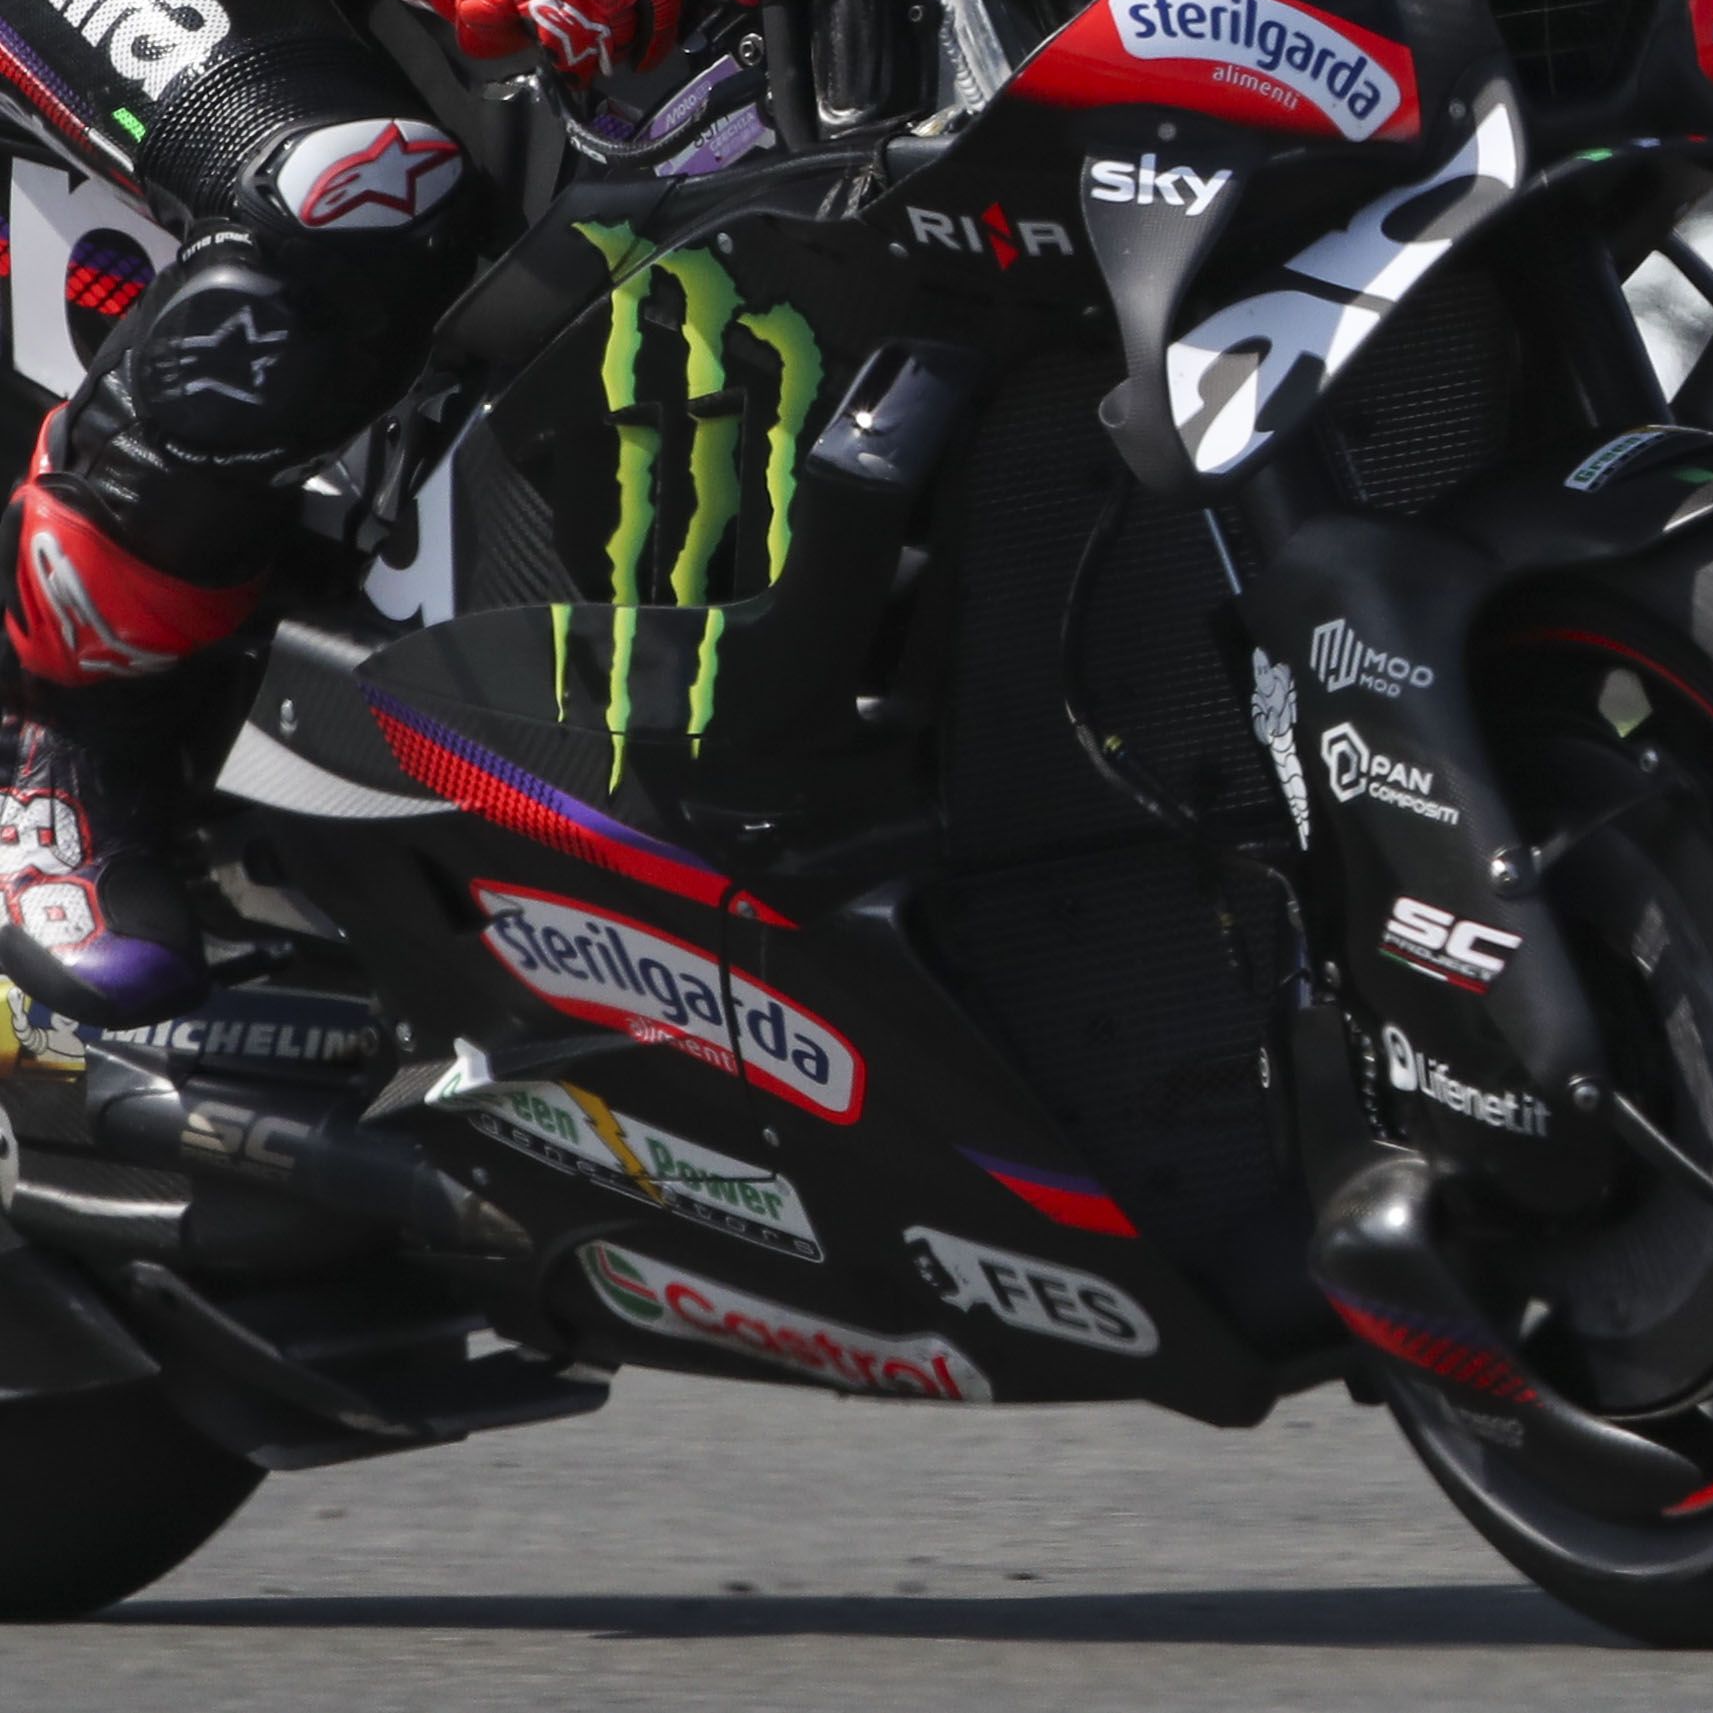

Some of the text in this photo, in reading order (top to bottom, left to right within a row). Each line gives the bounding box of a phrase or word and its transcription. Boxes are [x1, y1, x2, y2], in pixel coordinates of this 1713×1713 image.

[1212, 64, 1299, 111] alimenti
[1090, 153, 1232, 216] sky
[1359, 673, 1400, 698] MOD
[1363, 647, 1434, 687] MOD
[1370, 754, 1432, 795] PAN
[1388, 897, 1522, 972] SC
[492, 910, 832, 1086] sterilgarda
[1415, 1051, 1550, 1137] Lifenet.it
[181, 1100, 312, 1170] SC
[645, 1137, 784, 1222] Power
[665, 1282, 963, 1401] Castrol
